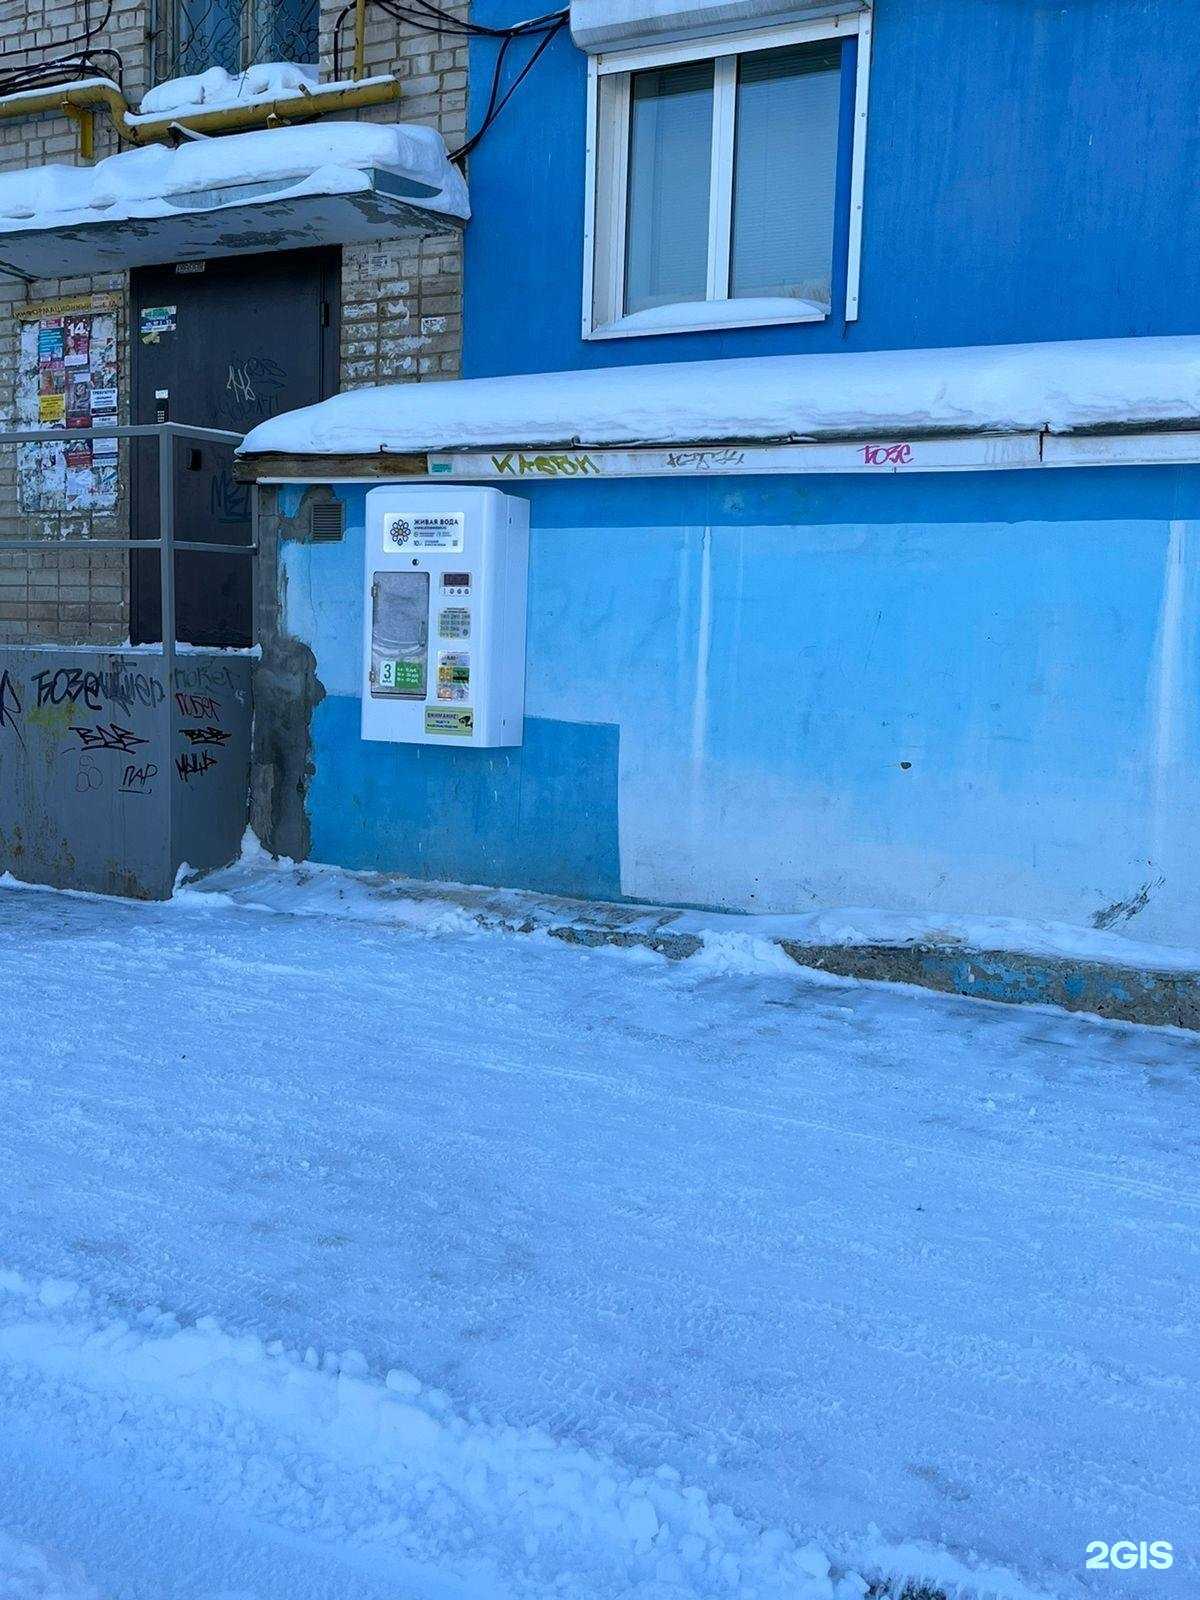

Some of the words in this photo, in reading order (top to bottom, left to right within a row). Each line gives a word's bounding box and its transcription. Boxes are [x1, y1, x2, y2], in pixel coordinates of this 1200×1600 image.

[413, 518, 438, 526] ЖИВАЯ
[440, 518, 459, 526] ВОДА
[384, 664, 391, 679] 3
